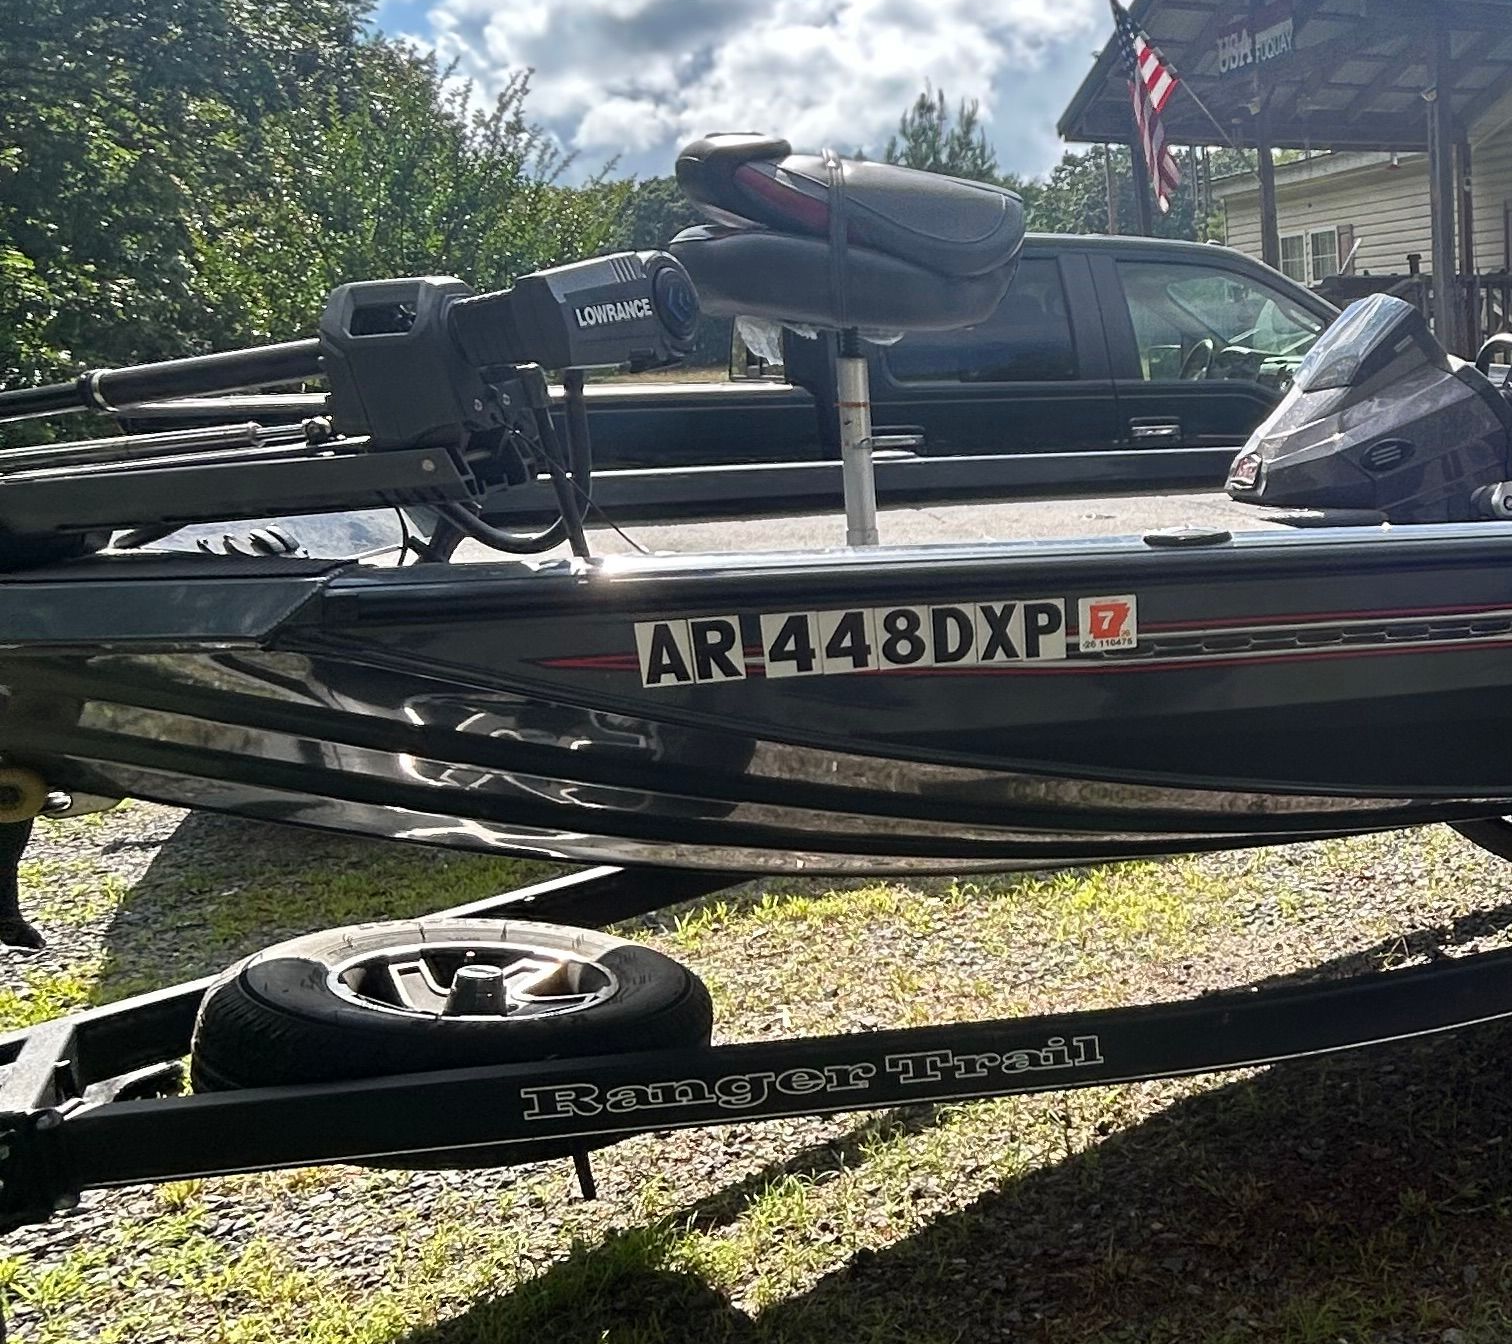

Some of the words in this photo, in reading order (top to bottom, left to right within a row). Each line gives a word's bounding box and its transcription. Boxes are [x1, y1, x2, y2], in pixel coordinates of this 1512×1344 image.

[575, 298, 653, 327] LOWRANCE
[1098, 610, 1114, 630] 7
[645, 618, 739, 684] AR
[520, 1061, 876, 1120] Ranger
[886, 1035, 1104, 1084] Trail
